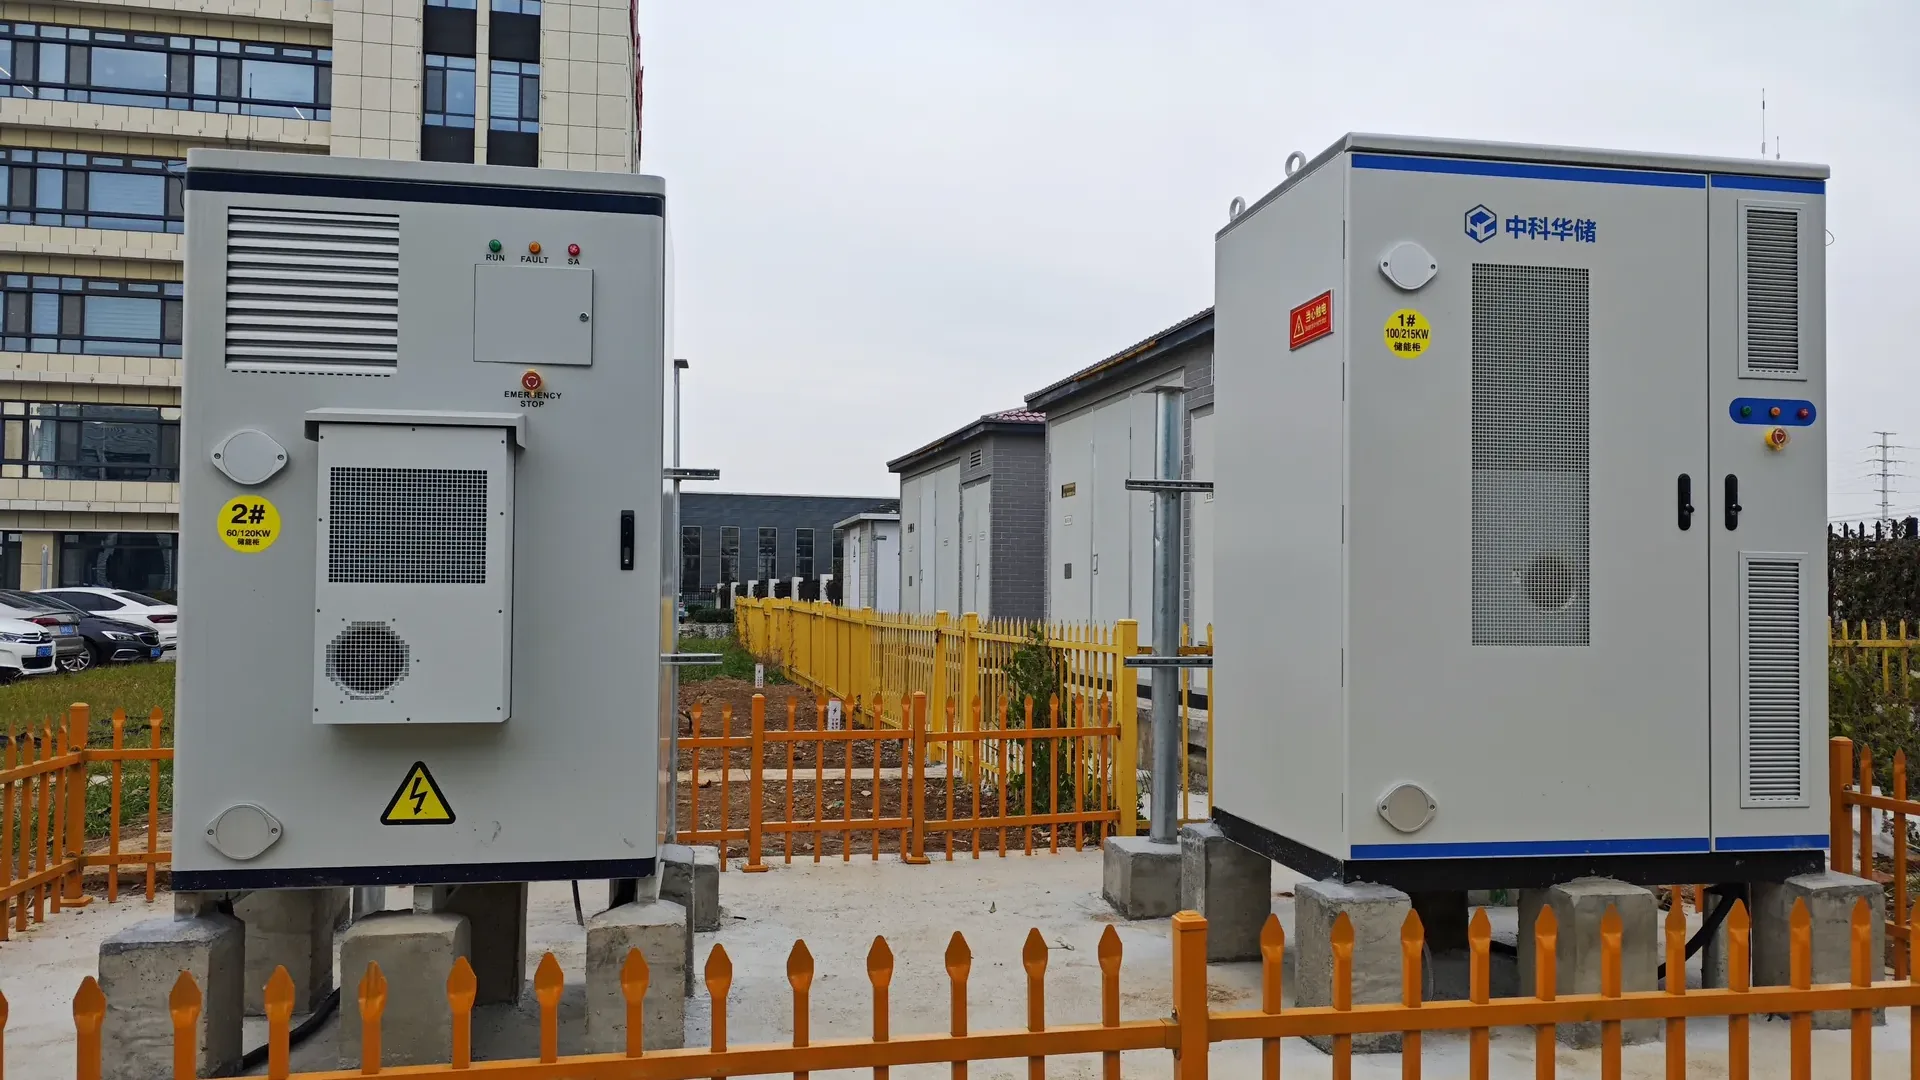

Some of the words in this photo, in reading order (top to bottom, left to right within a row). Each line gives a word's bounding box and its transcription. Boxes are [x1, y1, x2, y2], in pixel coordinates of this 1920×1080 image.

[1505, 214, 1597, 243] 中科华储
[485, 253, 505, 262] RUN
[520, 255, 549, 264] FAULT
[567, 257, 580, 265] SA
[1305, 302, 1327, 324] 当心触电
[1397, 313, 1416, 327] 1#
[1385, 327, 1429, 340] 100/215KW
[1393, 341, 1421, 352] 储能柜
[520, 400, 545, 408] STOP
[231, 503, 266, 524] 2#
[226, 529, 271, 537] 60/120KW
[237, 538, 260, 546] 储能柜
